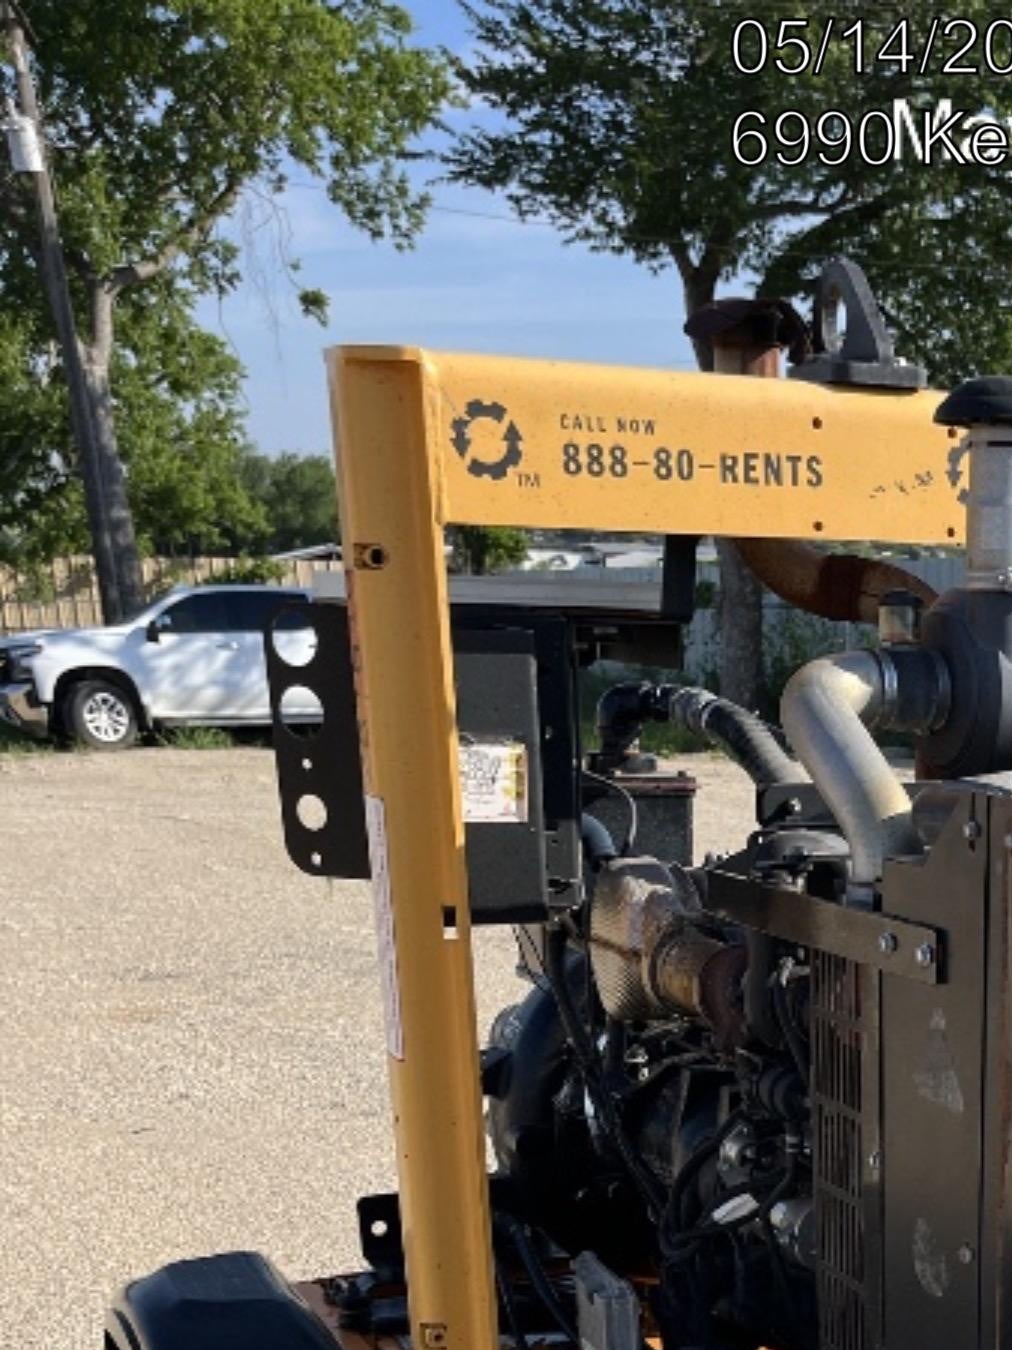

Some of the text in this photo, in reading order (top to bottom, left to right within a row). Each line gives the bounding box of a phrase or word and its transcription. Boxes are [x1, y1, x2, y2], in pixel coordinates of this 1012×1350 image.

[560, 413, 656, 436] CALL NOW
[563, 442, 823, 488] 888-80-RENTS
